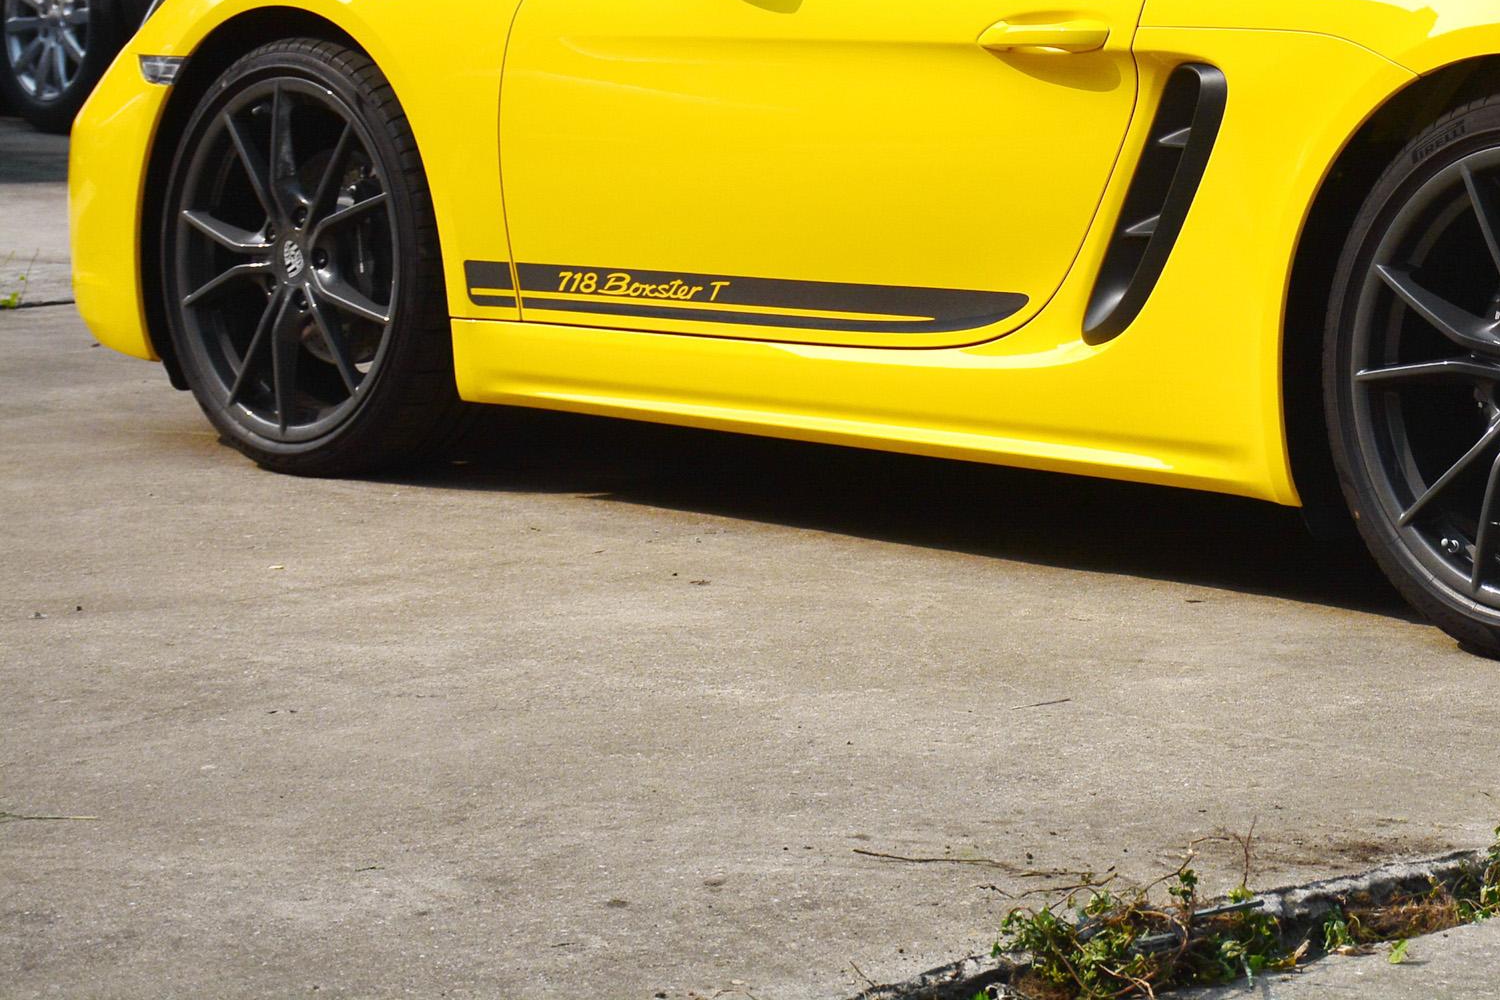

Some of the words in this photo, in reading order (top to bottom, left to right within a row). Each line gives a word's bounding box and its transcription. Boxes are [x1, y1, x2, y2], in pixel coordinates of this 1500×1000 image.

[558, 271, 598, 293] 718
[597, 272, 703, 300] Boxster
[710, 281, 731, 301] T
